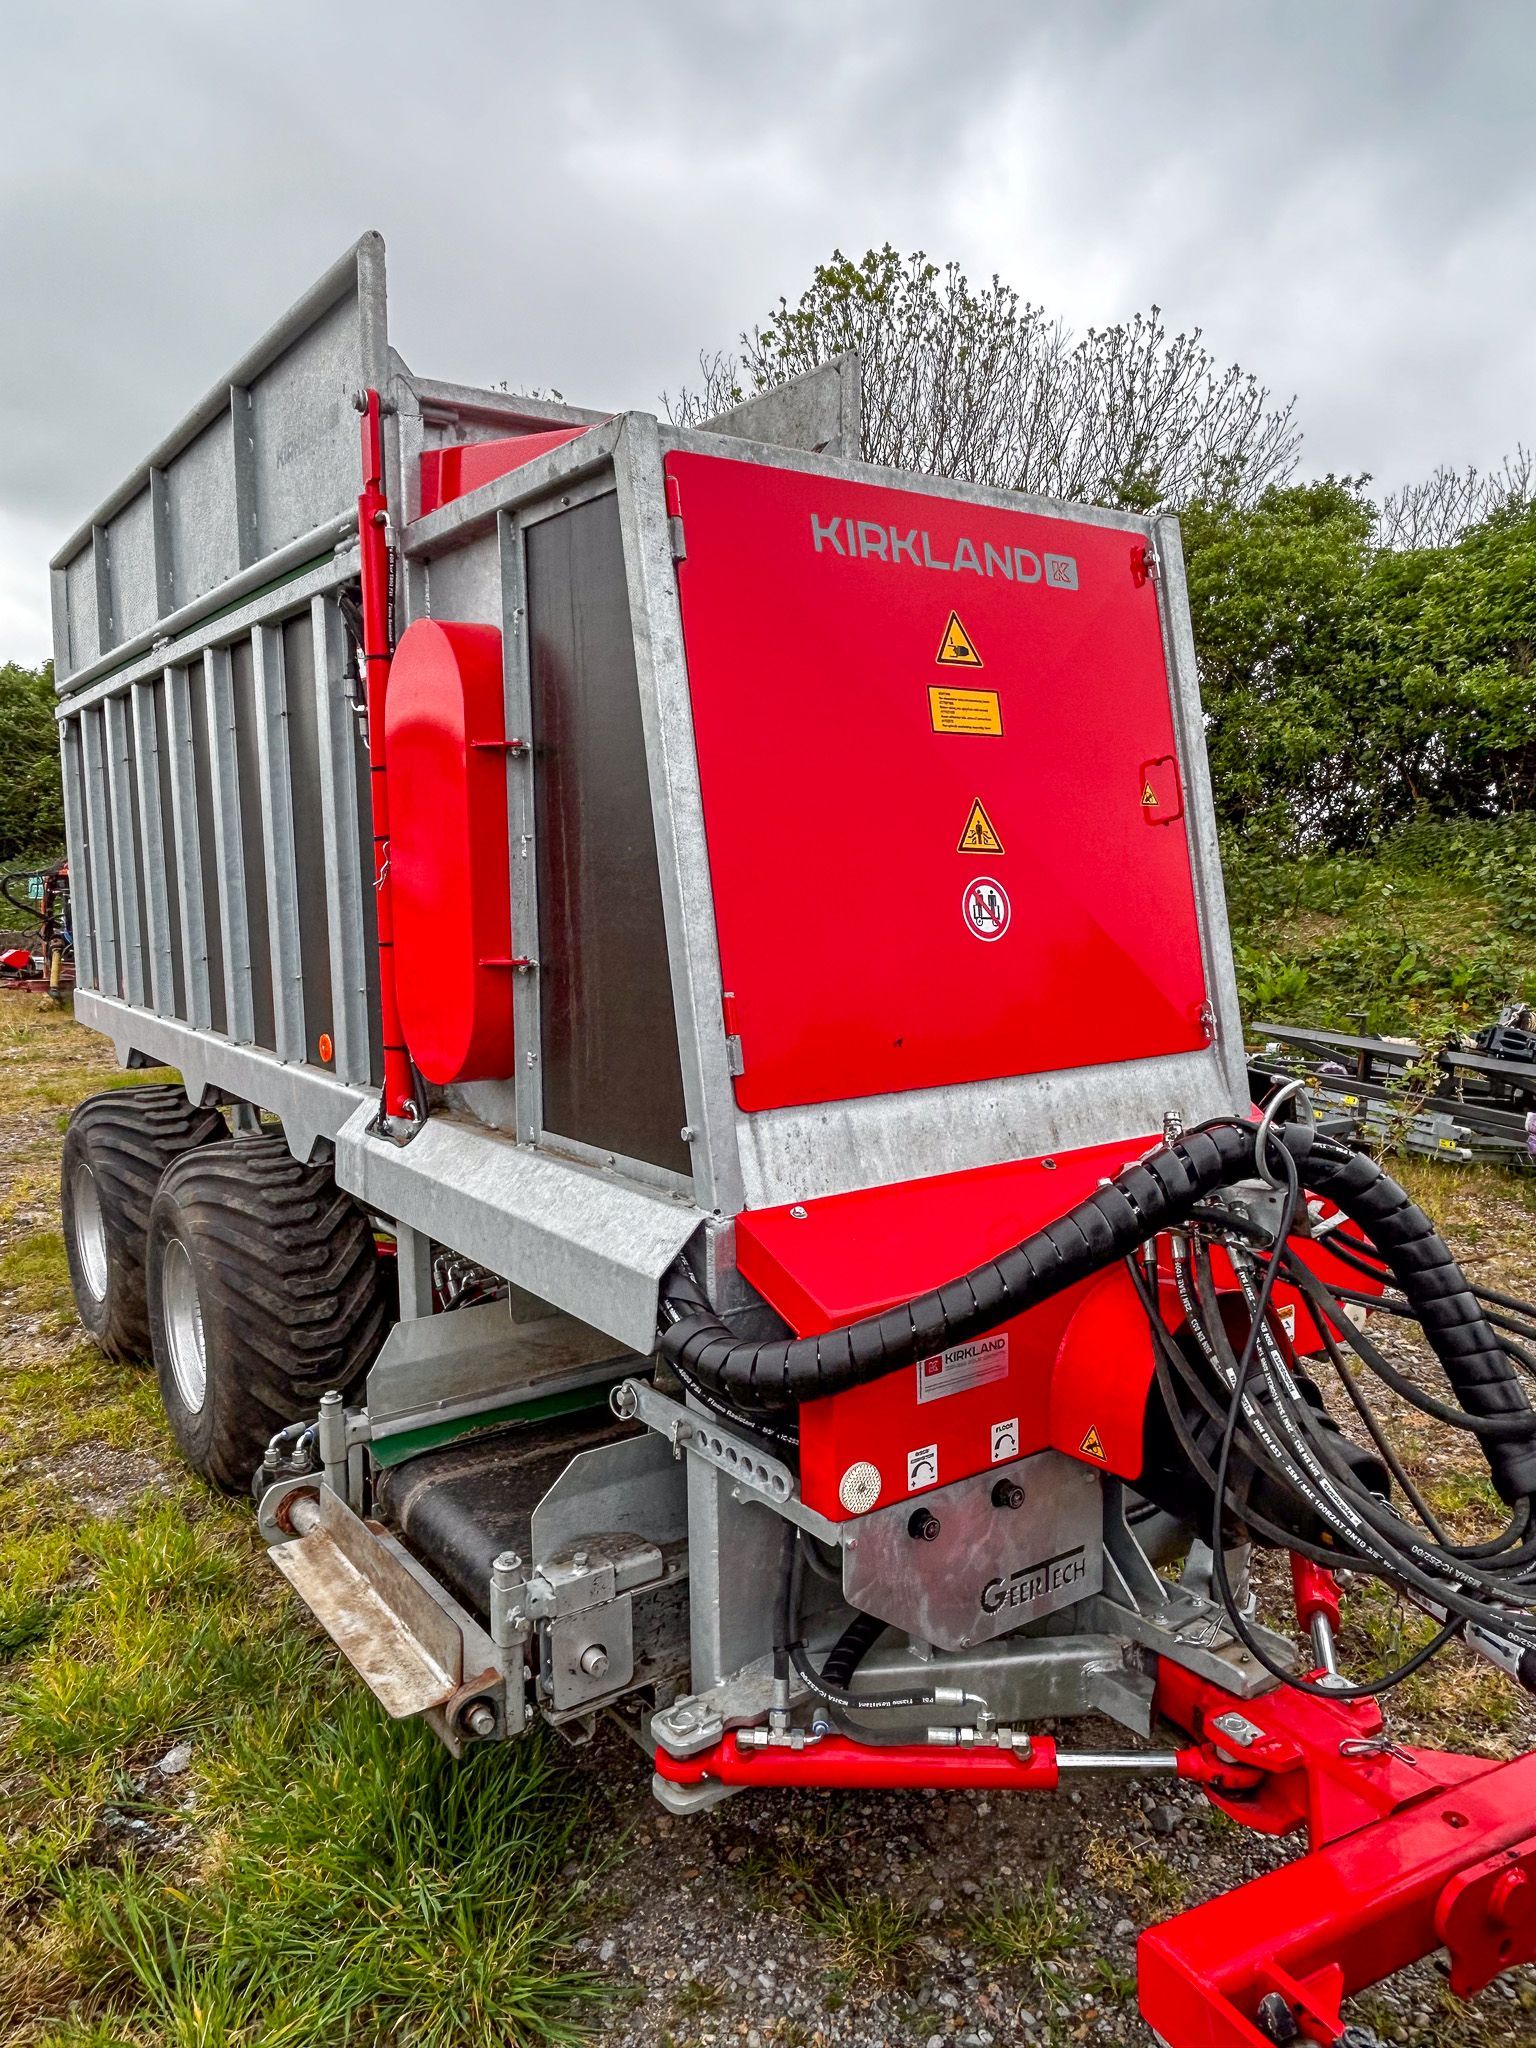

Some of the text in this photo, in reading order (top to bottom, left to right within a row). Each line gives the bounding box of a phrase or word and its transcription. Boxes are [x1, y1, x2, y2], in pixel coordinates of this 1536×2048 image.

[811, 513, 1042, 584] KIRKLAND
[945, 1338, 1005, 1365] KIRKLAND
[1253, 1419, 1265, 1434] DIN
[1262, 1431, 1273, 1445] EN
[1299, 1483, 1316, 1500] SAE
[1314, 1499, 1346, 1530] 100R2AT
[1344, 1528, 1367, 1548] DN10
[1309, 1463, 1320, 1477] DIN
